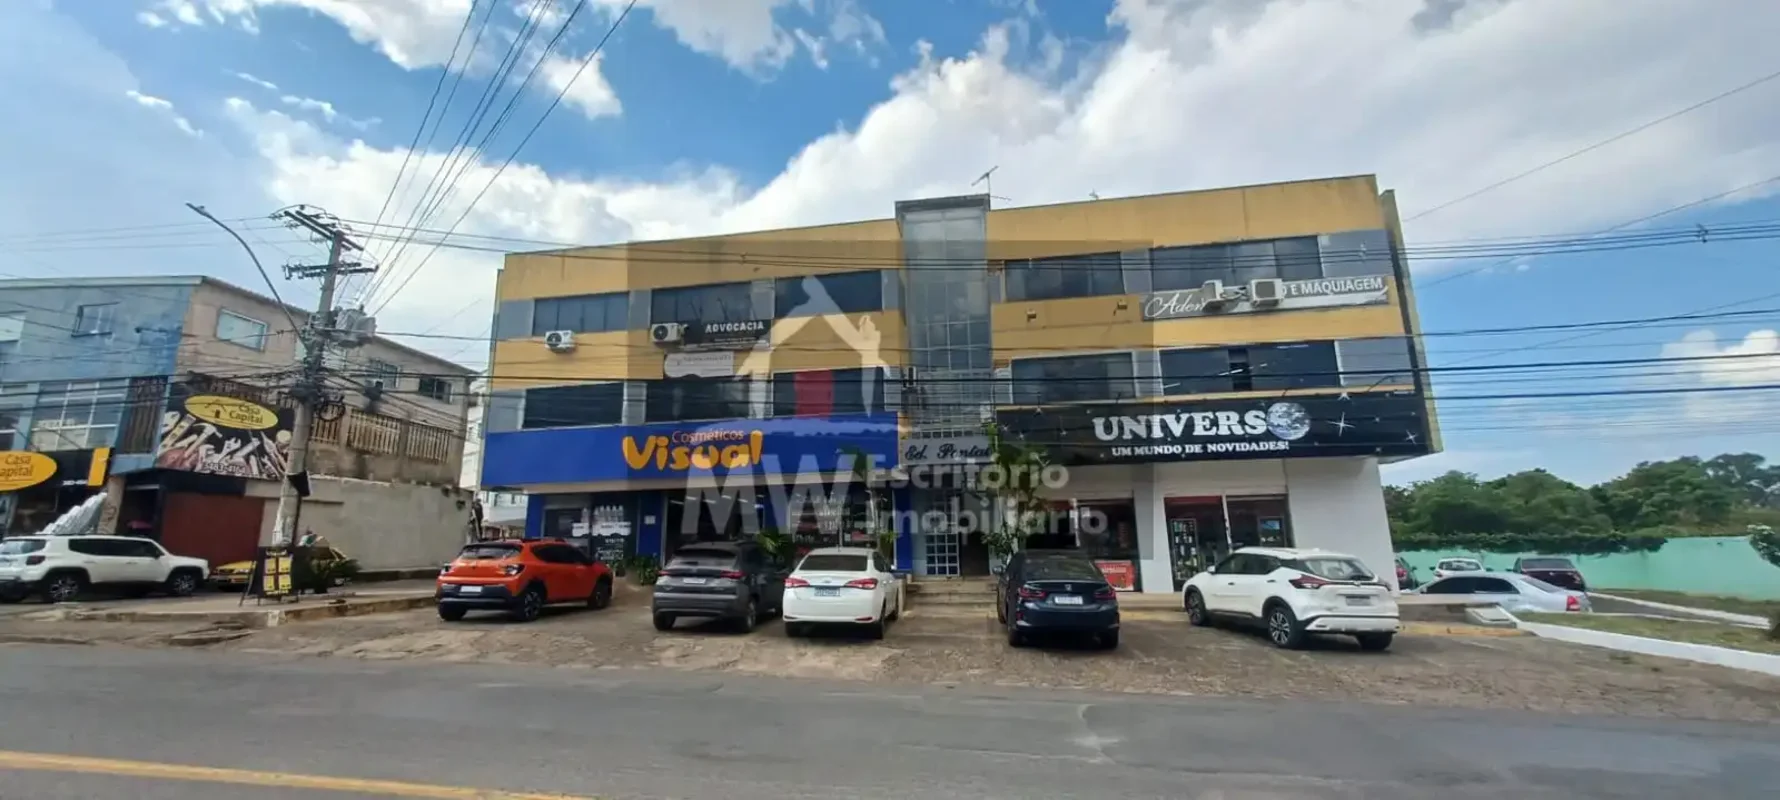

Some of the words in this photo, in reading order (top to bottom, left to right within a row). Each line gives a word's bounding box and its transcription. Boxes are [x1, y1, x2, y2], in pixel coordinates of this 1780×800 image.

[1301, 277, 1383, 295] MAQUIAGEM
[705, 321, 764, 334] ADVOCACIA
[229, 410, 264, 424] Capital
[672, 428, 744, 443] Cosméticos
[622, 430, 764, 471] Visual
[1112, 447, 1132, 456] UM
[1134, 444, 1182, 455] MUNDO
[1185, 443, 1203, 454] DE
[1207, 441, 1290, 453] NOVIDADES!
[0, 465, 34, 480] apital
